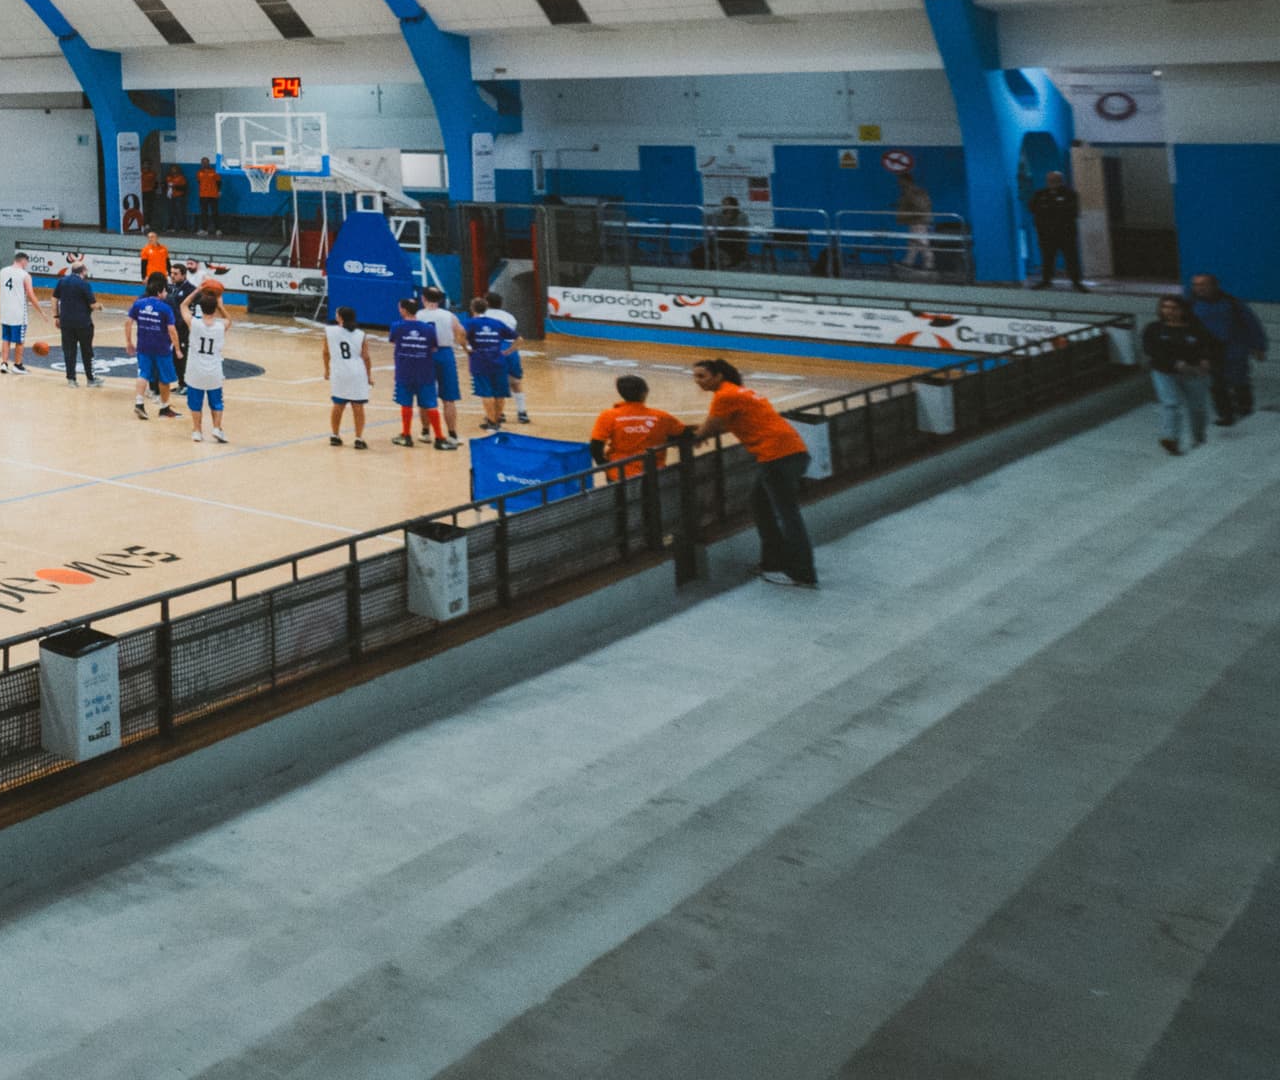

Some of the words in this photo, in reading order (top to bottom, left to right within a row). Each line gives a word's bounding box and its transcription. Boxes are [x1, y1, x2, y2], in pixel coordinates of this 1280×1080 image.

[273, 78, 299, 98] 24
[32, 264, 50, 273] acb
[5, 277, 14, 291] 4
[561, 290, 654, 308] Fundación
[628, 308, 663, 321] acb
[198, 337, 215, 355] 11
[340, 341, 352, 360] 8
